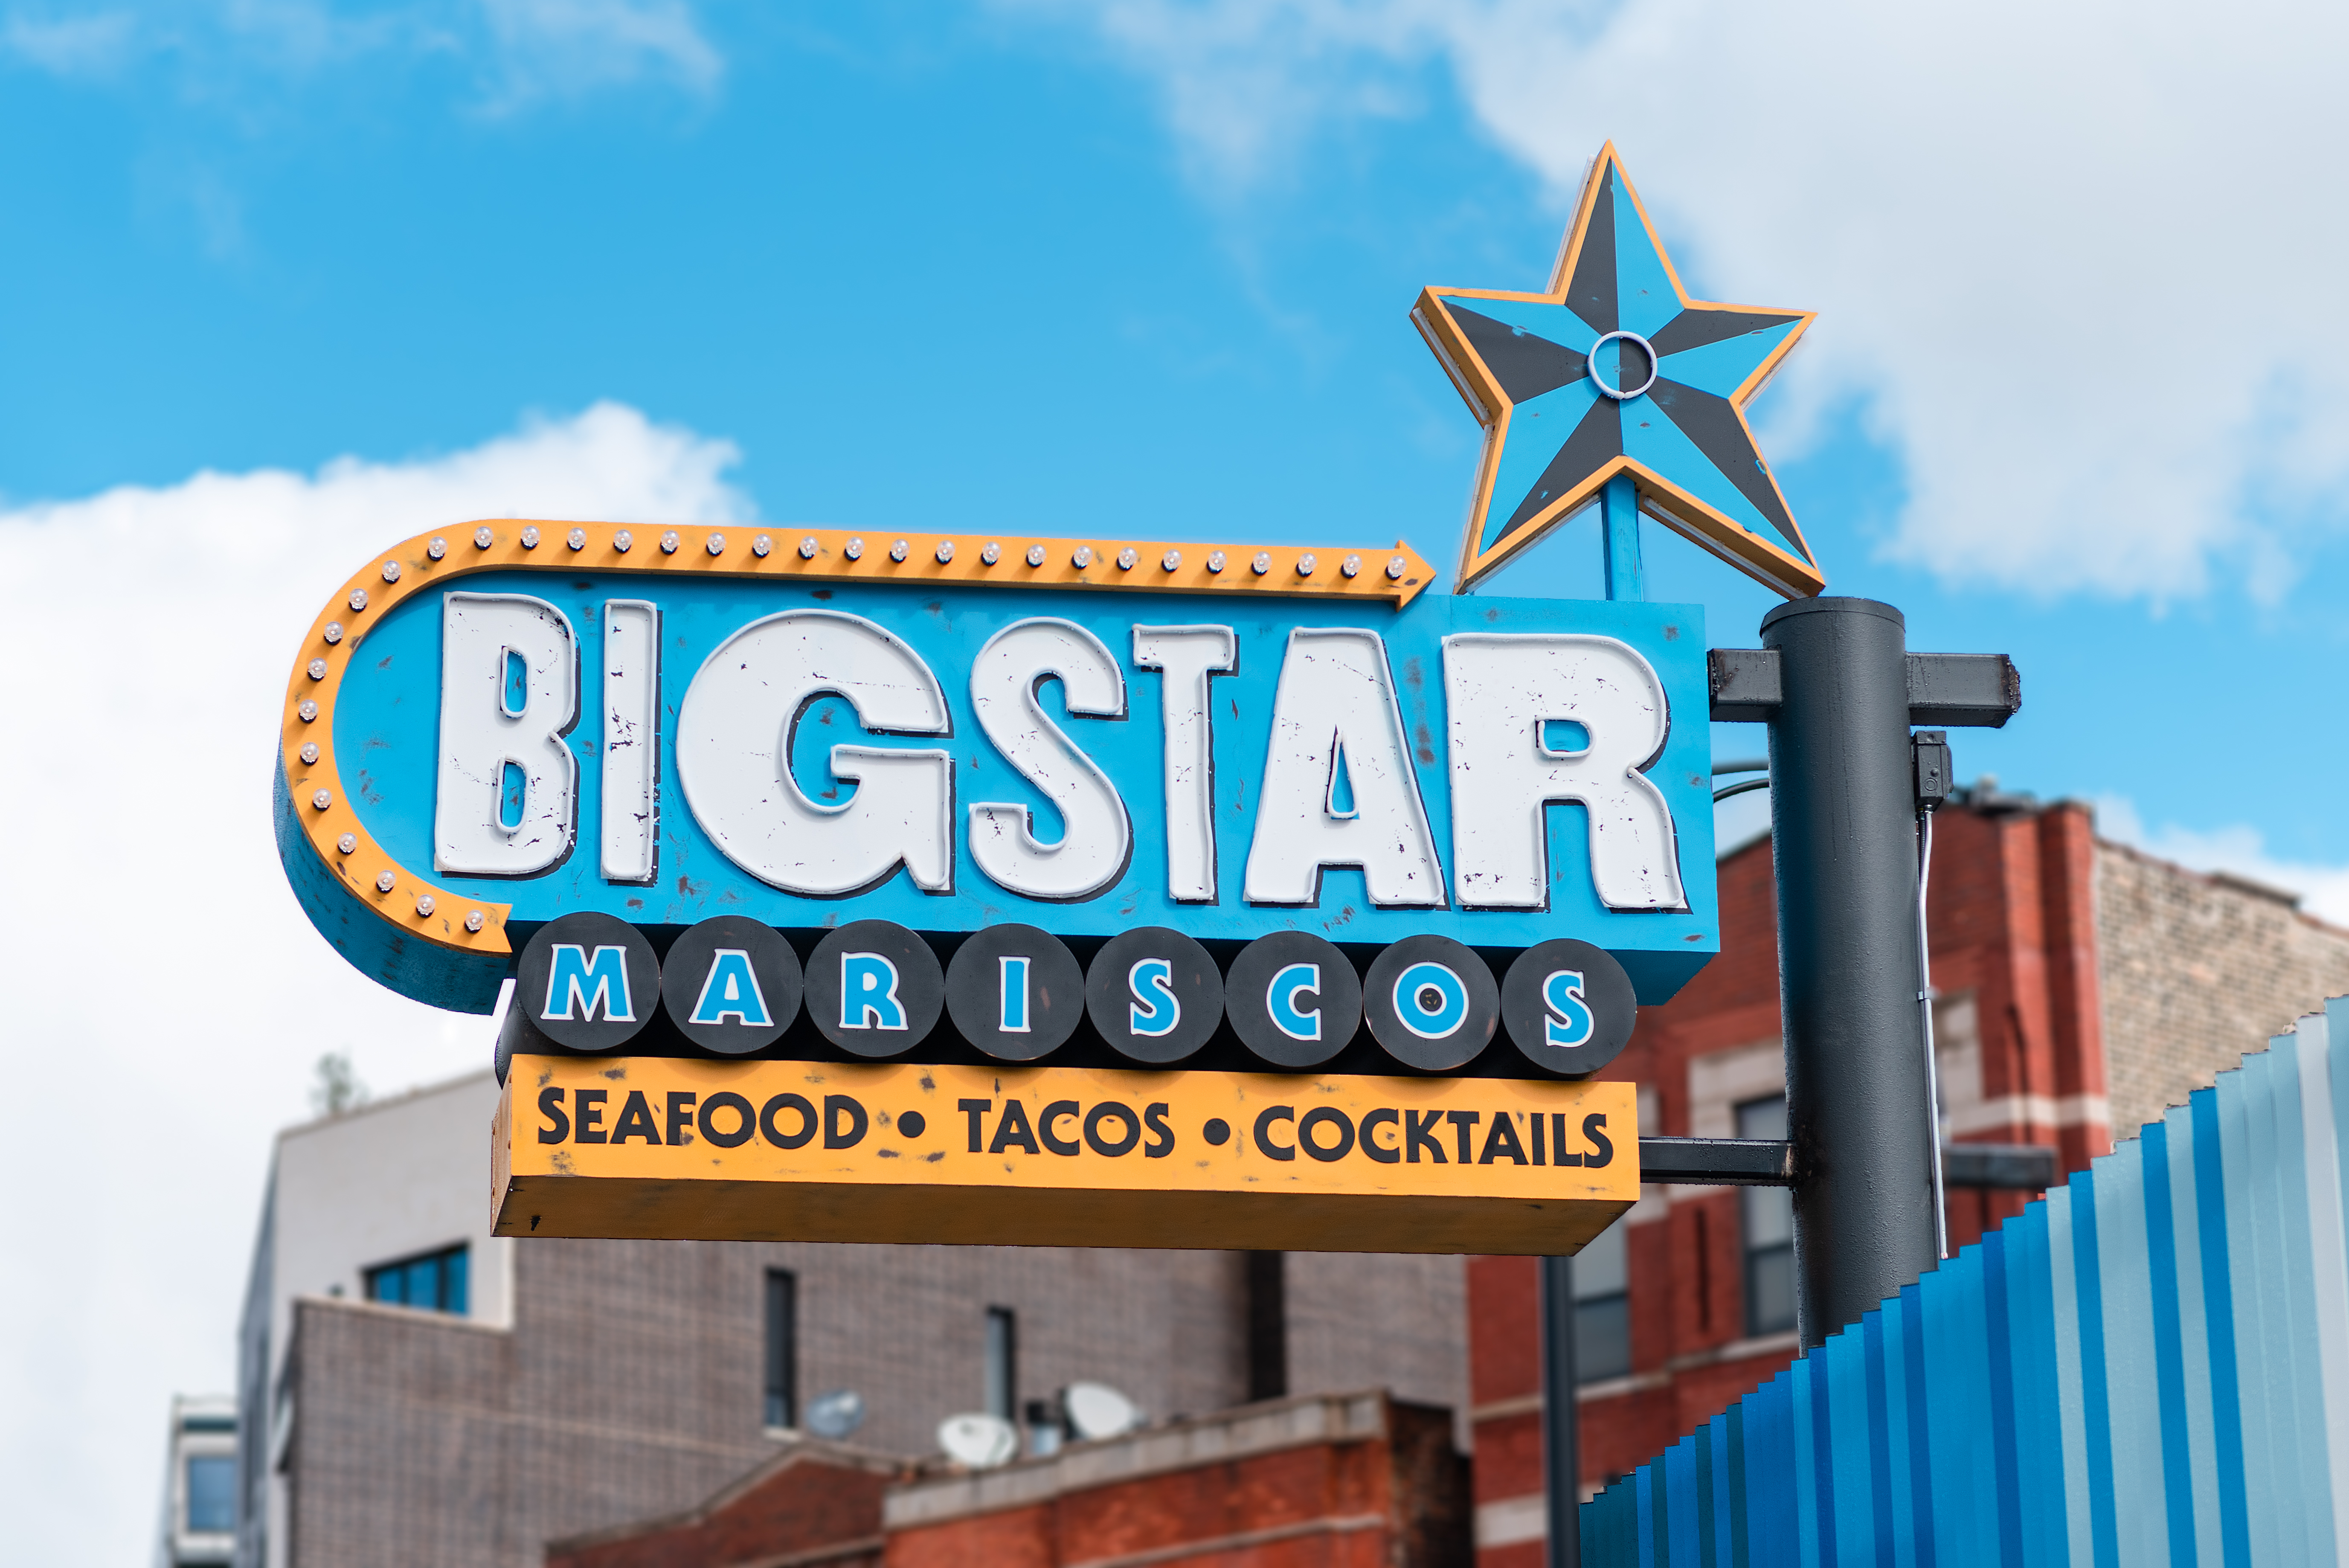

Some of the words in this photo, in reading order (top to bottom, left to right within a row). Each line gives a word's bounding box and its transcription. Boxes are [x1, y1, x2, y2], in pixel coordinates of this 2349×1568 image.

[540, 943, 1595, 1048] MARISCOS
[537, 1086, 869, 1150] SEAFOOD
[958, 1098, 1175, 1159] TACOS
[1253, 1105, 1614, 1168] COCKTAILS
